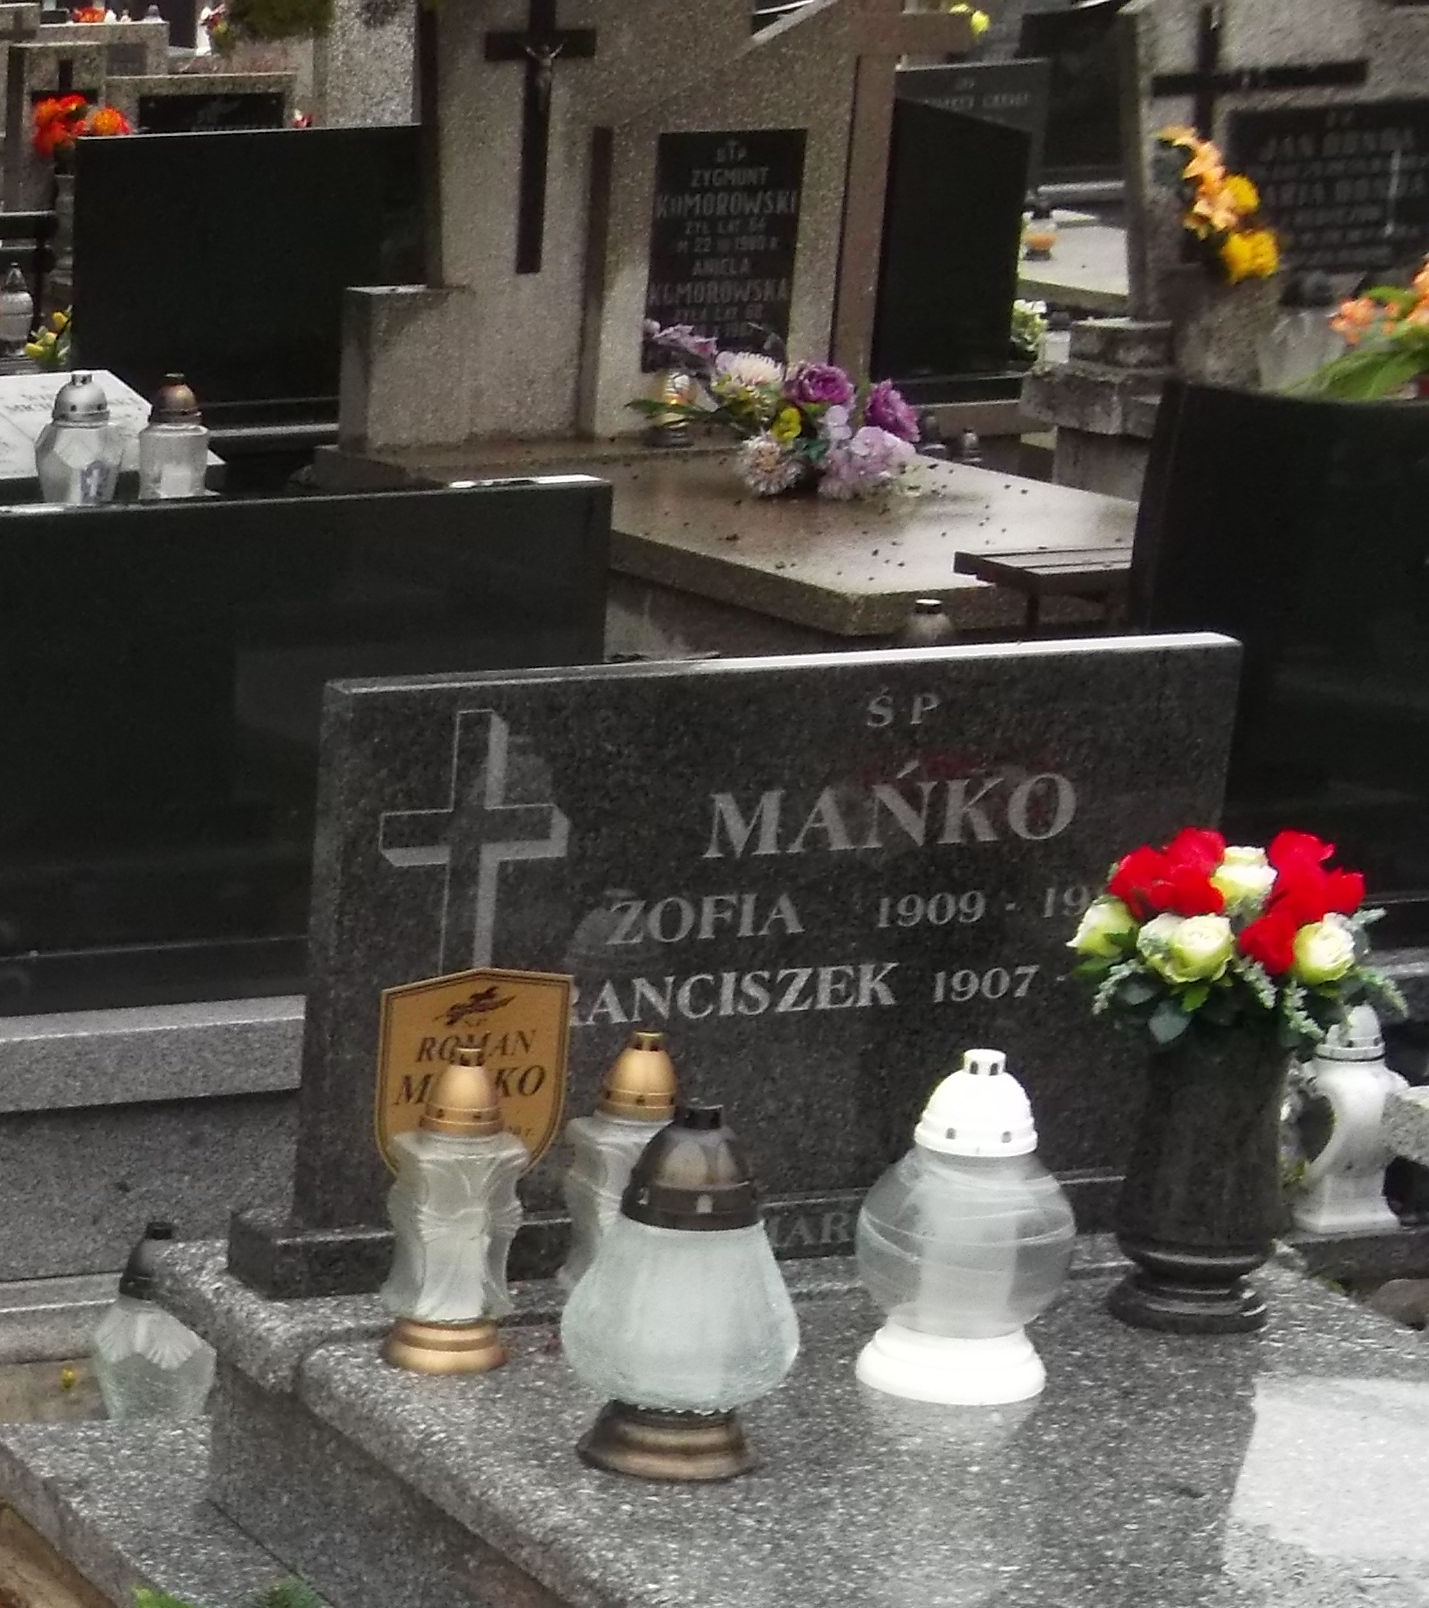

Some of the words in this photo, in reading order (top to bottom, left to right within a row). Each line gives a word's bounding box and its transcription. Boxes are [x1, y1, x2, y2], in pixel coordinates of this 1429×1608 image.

[703, 757, 1078, 861] MAŃKO
[605, 890, 806, 946] ZOFIA
[877, 889, 987, 929] 1909
[933, 964, 1041, 1004] 1907
